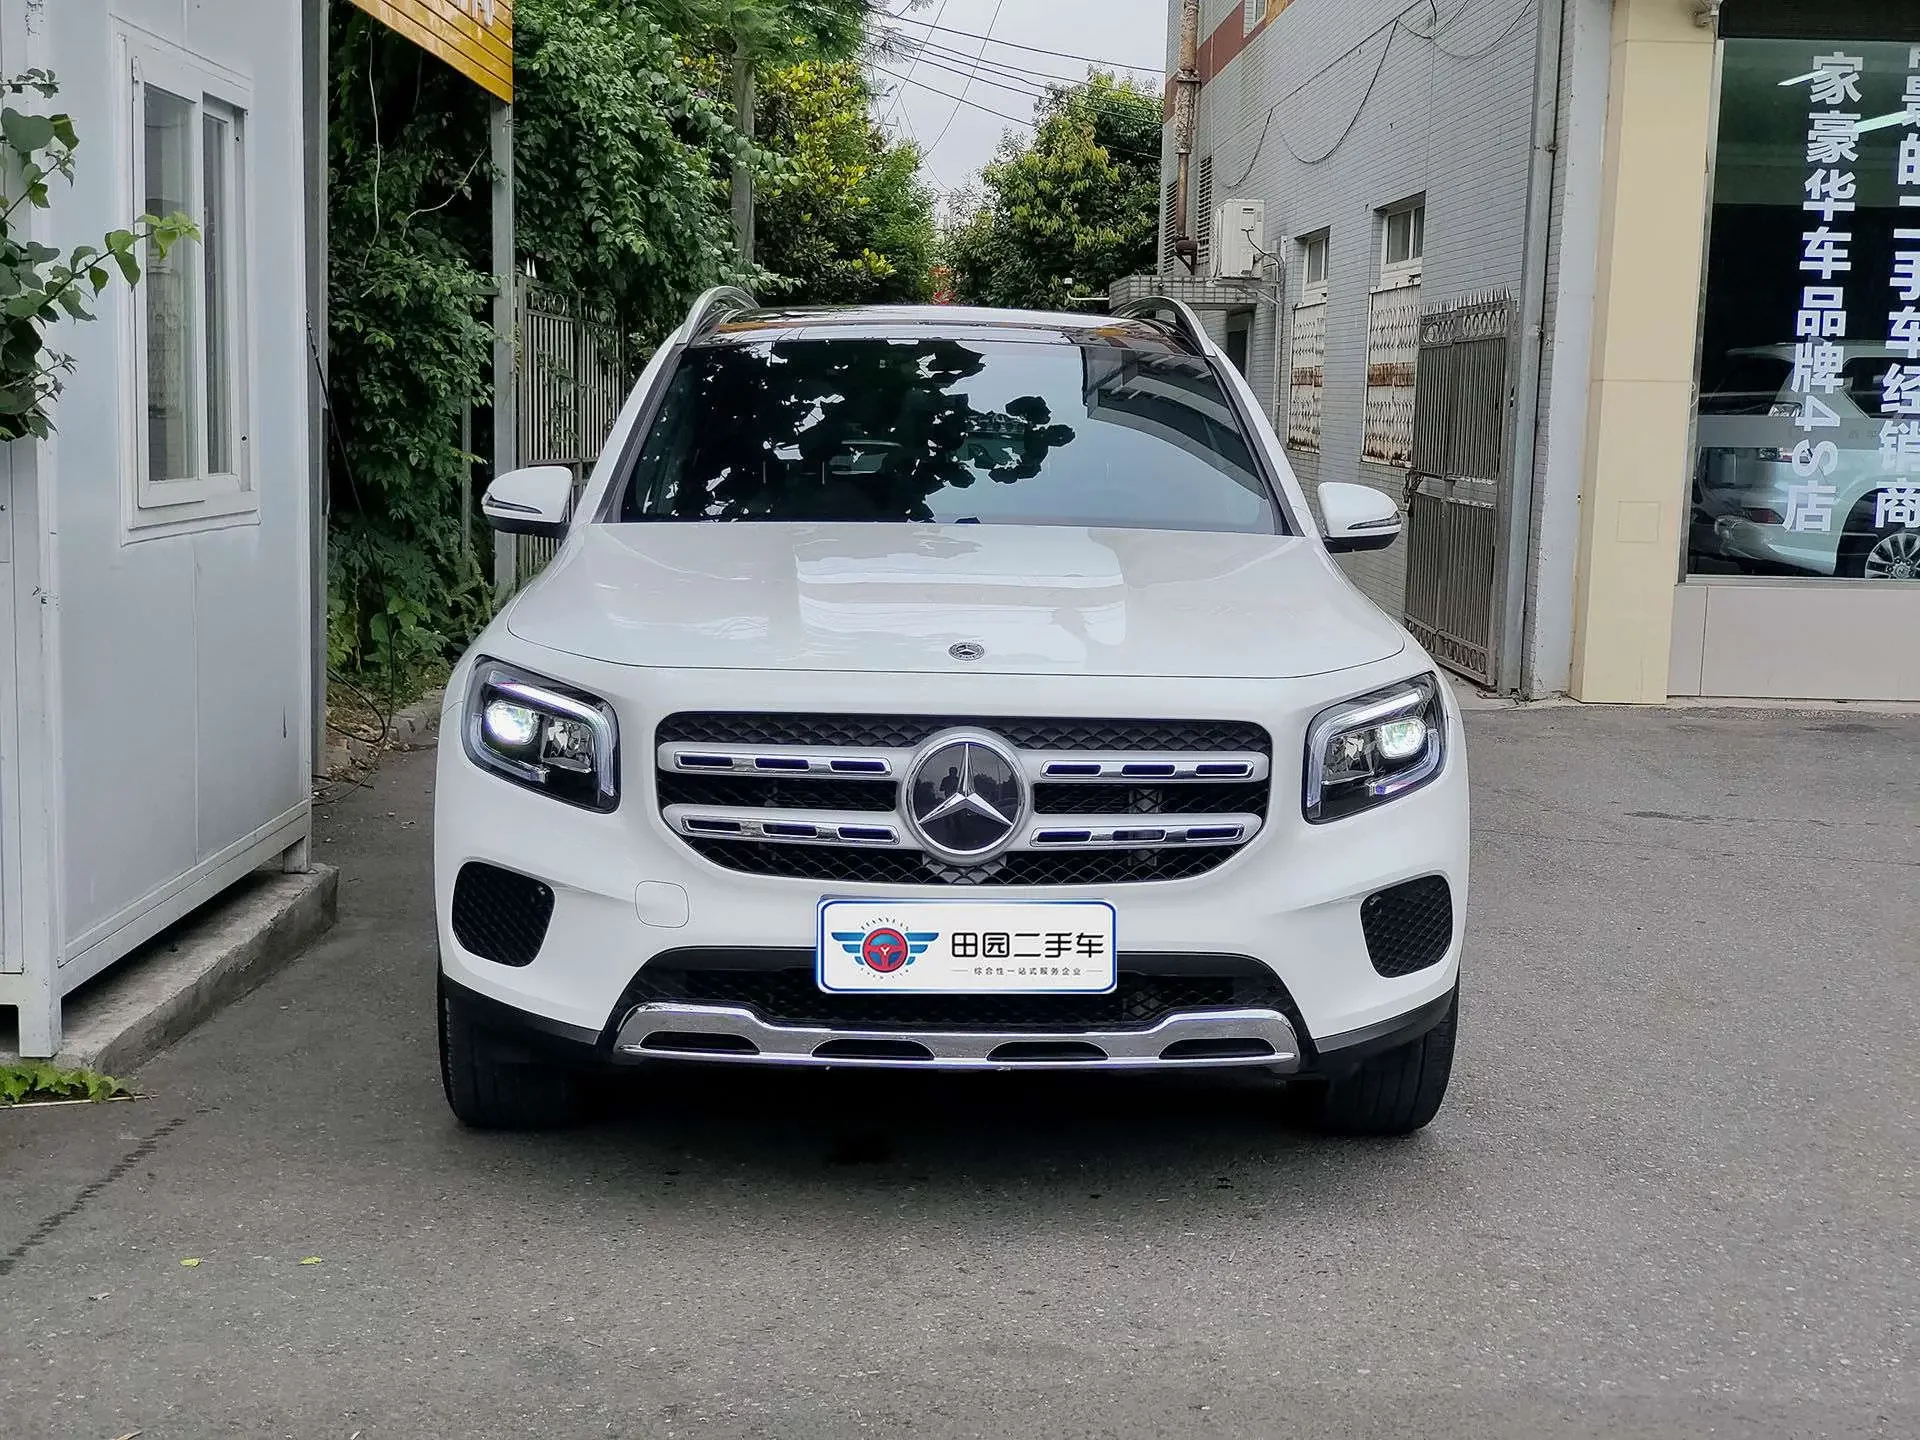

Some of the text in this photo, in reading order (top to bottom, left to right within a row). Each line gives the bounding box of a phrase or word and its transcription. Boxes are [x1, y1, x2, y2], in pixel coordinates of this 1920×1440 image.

[1782, 52, 1864, 532] 家豪华车品牌4S店
[951, 931, 1105, 959] 田园二手车
